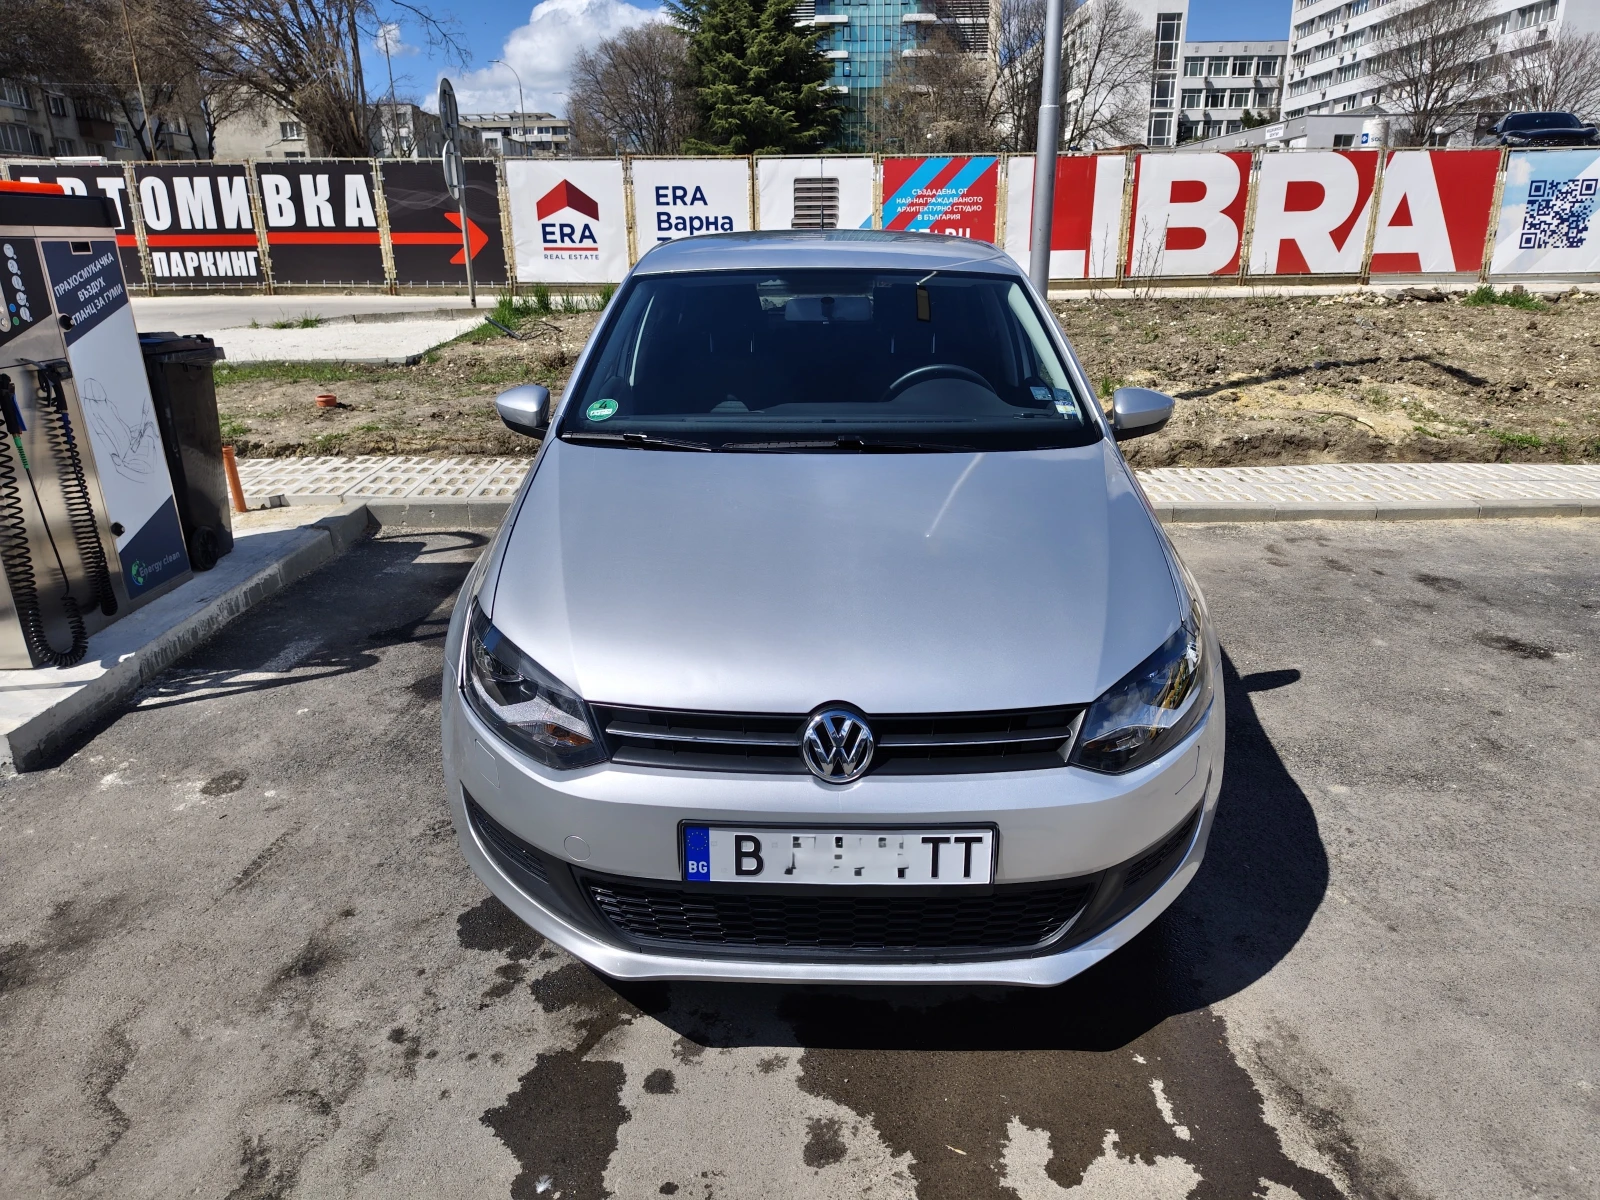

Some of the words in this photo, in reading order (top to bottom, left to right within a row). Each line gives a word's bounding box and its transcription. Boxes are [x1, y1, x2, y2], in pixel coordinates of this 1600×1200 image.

[19, 173, 377, 230] ТОМИВКА
[655, 185, 708, 206] ERA
[896, 196, 983, 204] НАЙ-НАГРАЖДАВАНОТО
[911, 188, 957, 196] СЪЗДАДЕНА
[924, 213, 961, 221] БЪЛГАРИЯ
[953, 205, 982, 213] СТУДИО
[1006, 150, 1455, 278] LIBRA
[541, 223, 598, 244] ERA
[656, 211, 734, 236] Варна
[54, 252, 115, 297] ПРАХОСМУКАЧКА
[152, 250, 259, 278] ПАРКИНГ
[77, 276, 106, 302] ВЪЗДУХ
[72, 302, 98, 326] ГЛАНЦ
[94, 297, 105, 310] ЗА
[104, 283, 124, 304] ГУМИ
[599, 400, 608, 409] 4
[139, 560, 163, 577] Energy
[162, 551, 181, 565] clean
[688, 861, 708, 874] BG
[735, 835, 764, 876] B
[921, 836, 983, 878] TT
